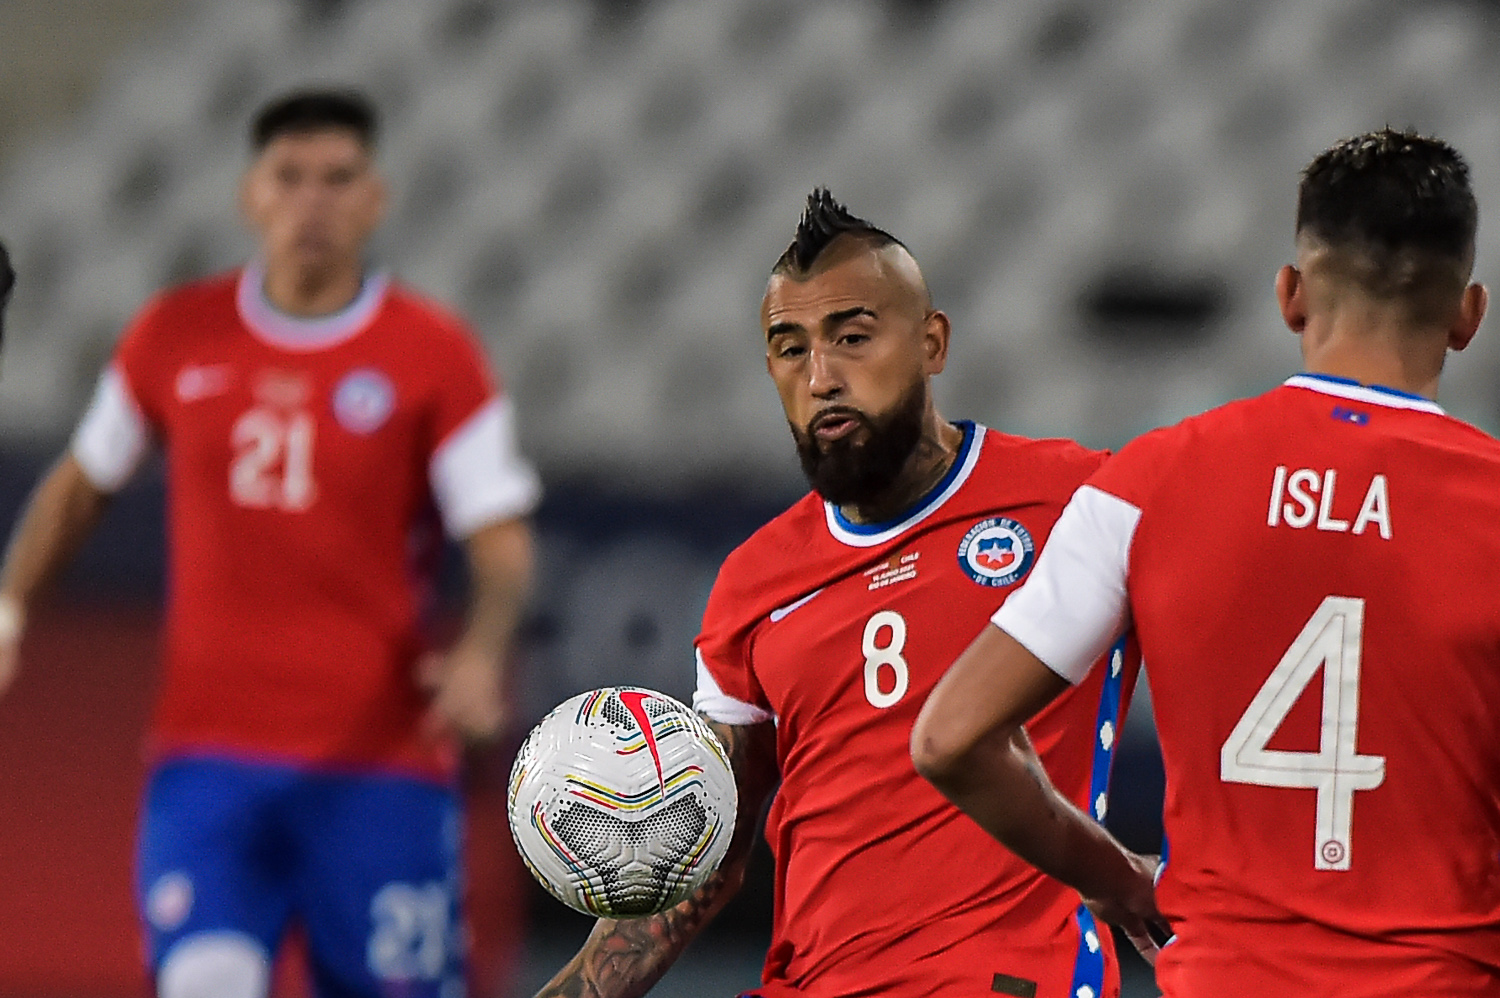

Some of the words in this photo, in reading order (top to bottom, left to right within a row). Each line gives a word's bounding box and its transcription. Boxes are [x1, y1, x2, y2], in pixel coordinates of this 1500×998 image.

[229, 405, 318, 513] 21
[1267, 465, 1393, 540] ISLA
[991, 572, 1016, 587] CHILE
[862, 610, 909, 709] 8
[1220, 595, 1386, 872] 4
[366, 880, 449, 983] 21
